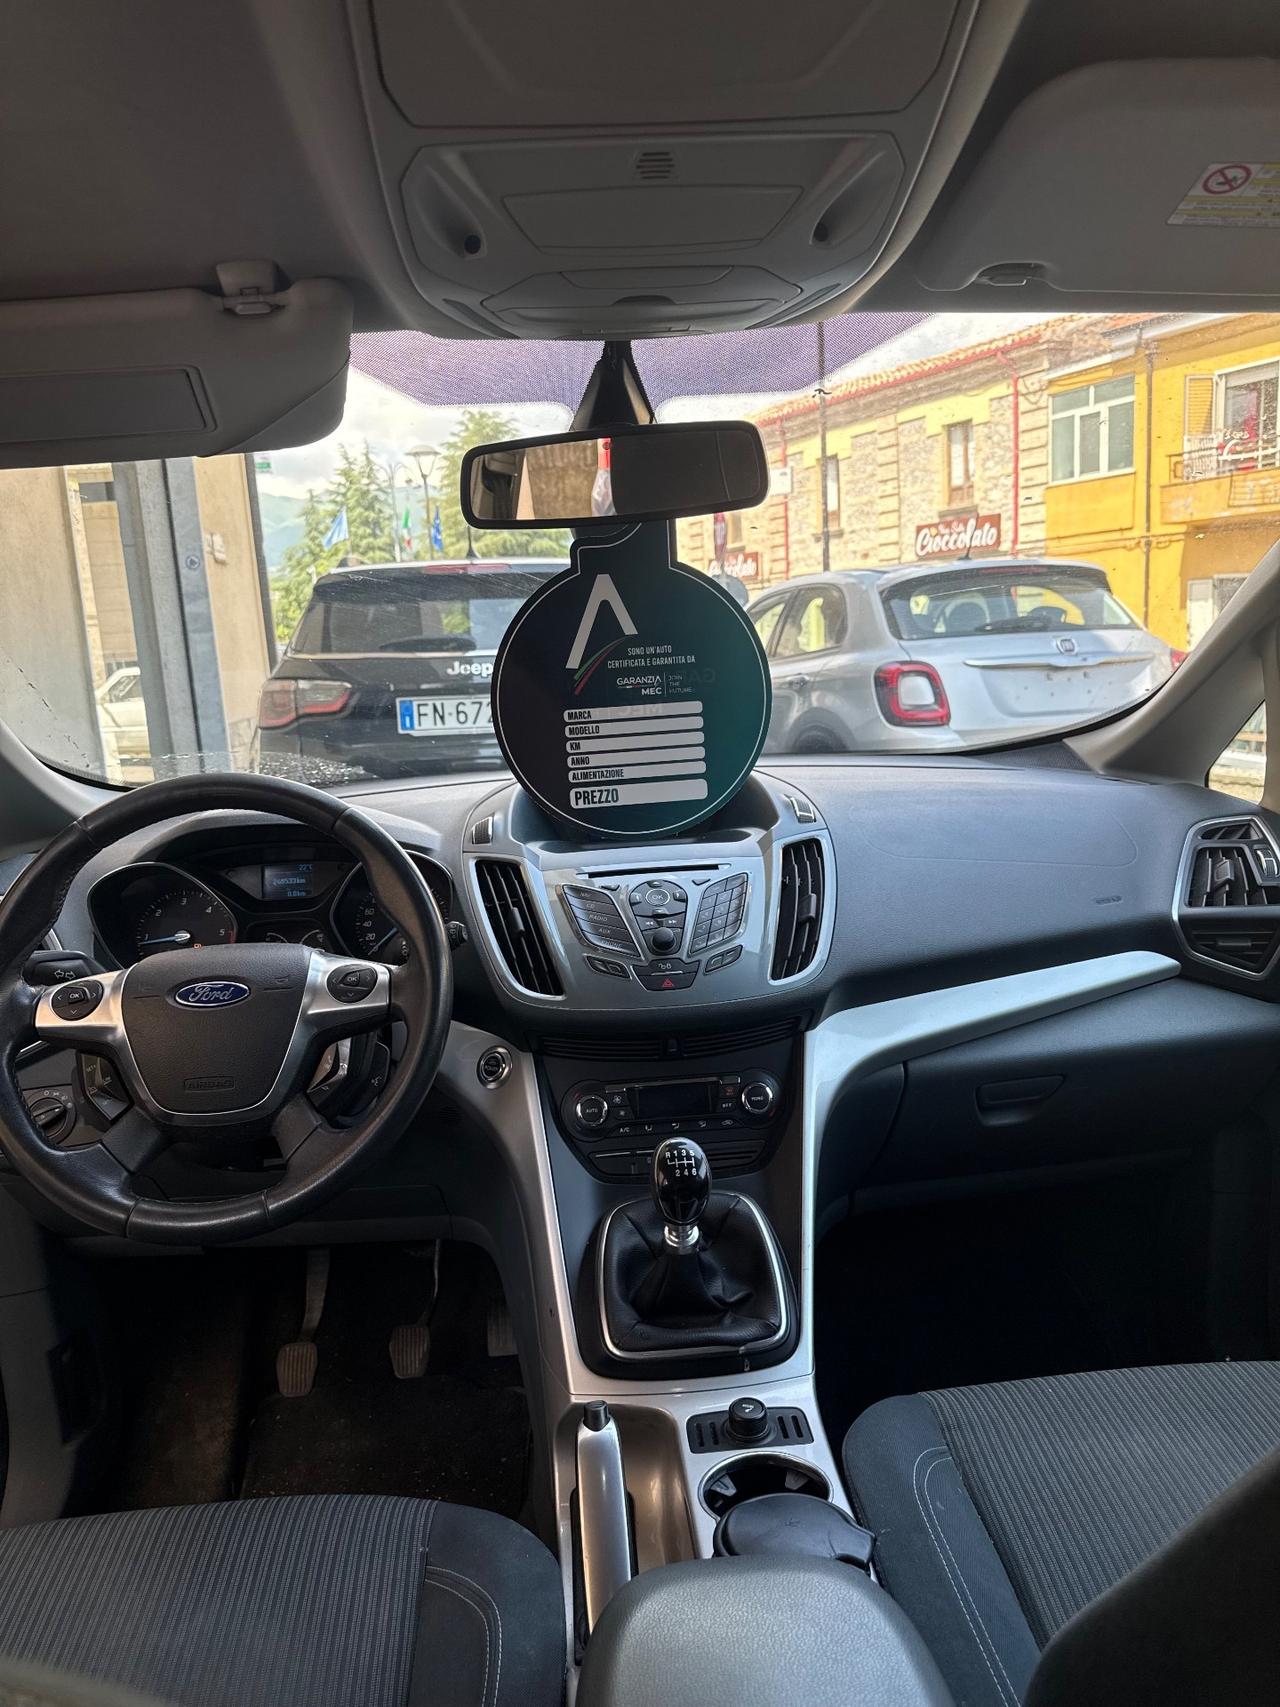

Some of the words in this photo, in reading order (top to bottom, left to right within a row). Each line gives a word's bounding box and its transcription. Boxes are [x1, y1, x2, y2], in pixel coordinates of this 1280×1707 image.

[916, 518, 998, 556] Cioccolato
[627, 647, 645, 656] SONO
[645, 645, 672, 655] UN'AUTO
[607, 659, 646, 669] CERTIFICATA
[646, 658, 651, 666] E
[652, 656, 686, 666] GARANTITA
[687, 655, 696, 664] DA
[446, 661, 493, 678] Jeep
[616, 675, 662, 686] GARANZIA
[641, 687, 662, 696] MEC
[416, 701, 446, 727] FN
[567, 710, 592, 720] MARCA
[568, 725, 600, 736] MODELLO
[569, 741, 581, 751] KM
[570, 756, 590, 766] ANNO
[572, 769, 625, 781] ALIMENTAZIONE
[574, 788, 620, 806] PREZZO
[188, 984, 235, 1002] Ford
[675, 1169, 680, 1177] 2
[691, 1168, 697, 1176] 6
